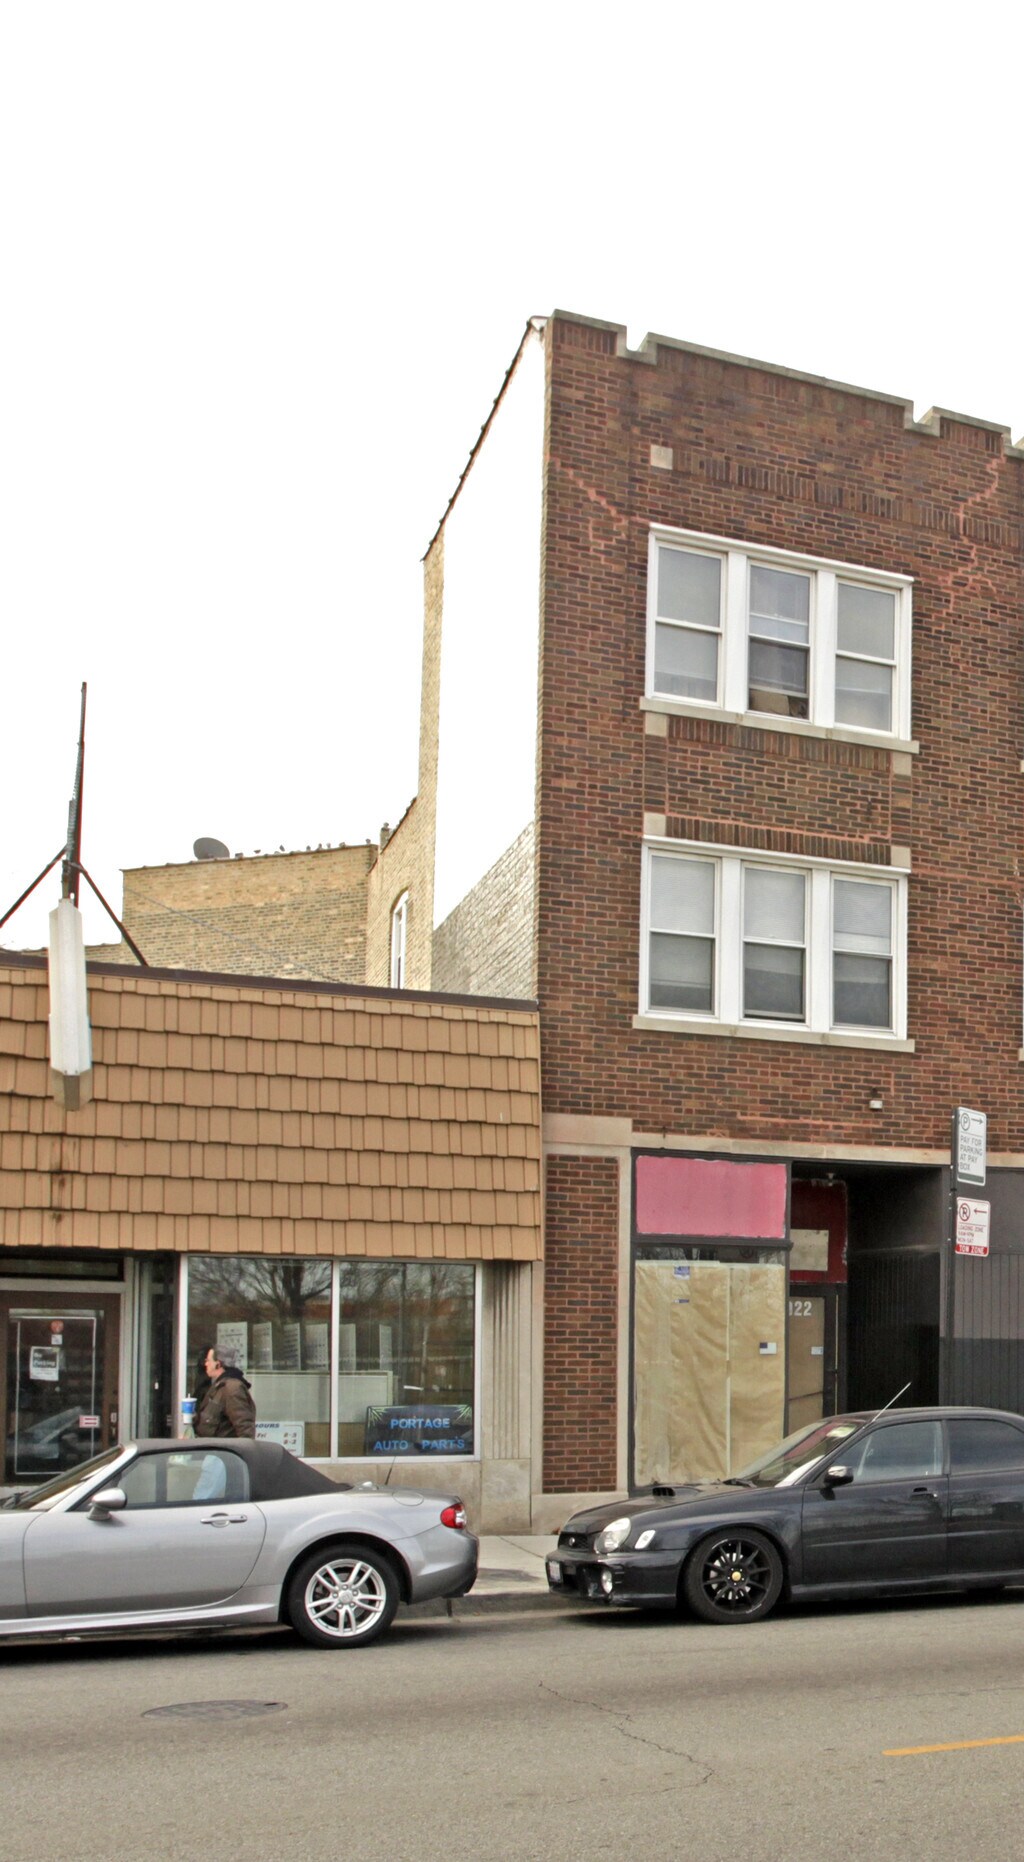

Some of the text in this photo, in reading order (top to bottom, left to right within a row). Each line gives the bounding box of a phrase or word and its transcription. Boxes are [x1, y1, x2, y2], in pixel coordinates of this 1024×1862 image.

[960, 1135, 982, 1146] PAY FOR
[960, 1144, 983, 1156] PARKING
[960, 1153, 978, 1163] AT PAY
[959, 1161, 970, 1171] BOX
[959, 1244, 985, 1255] TOW ZONE
[390, 1418, 450, 1429] PORTAGE
[373, 1440, 409, 1451] AUTO
